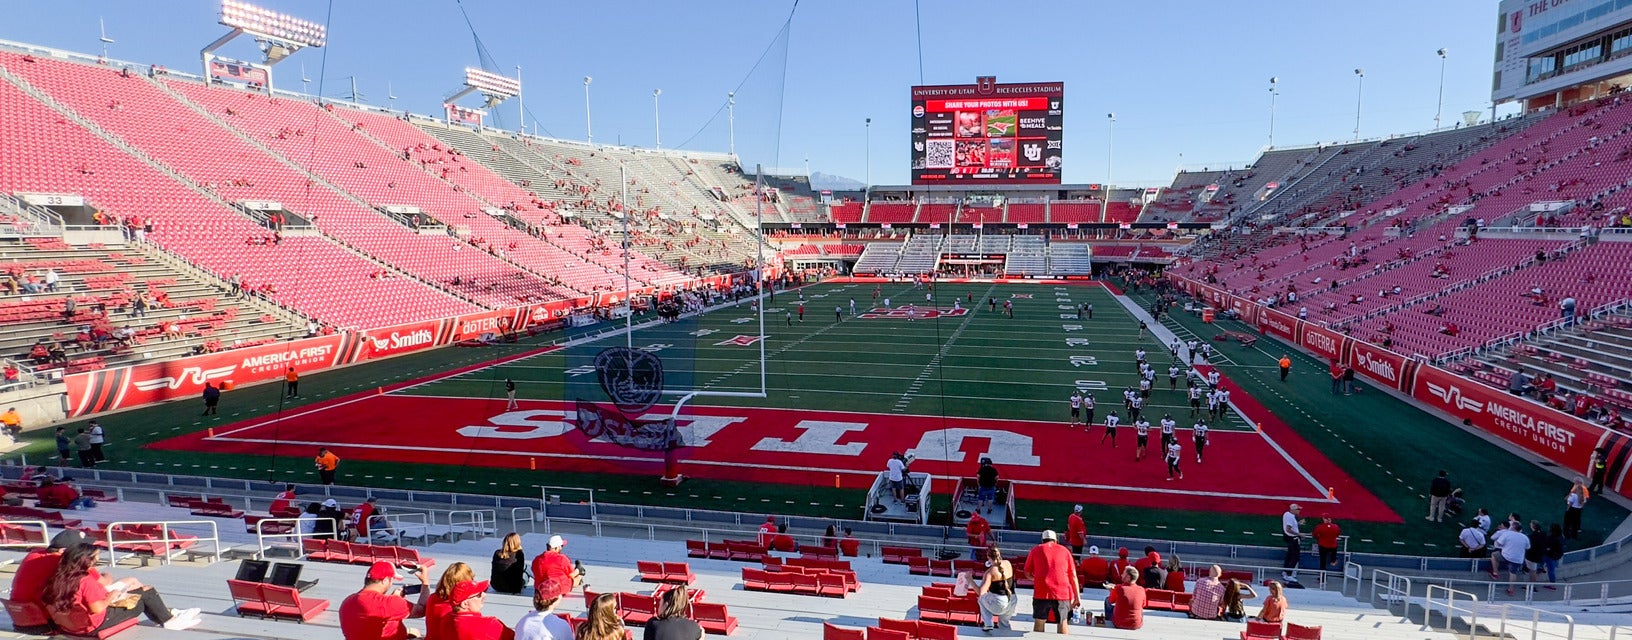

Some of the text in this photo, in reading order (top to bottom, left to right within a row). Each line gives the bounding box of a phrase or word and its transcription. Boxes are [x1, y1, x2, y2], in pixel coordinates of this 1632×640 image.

[1529, 0, 1549, 17] THE
[47, 196, 63, 205] 33
[390, 328, 433, 349] Smith's
[241, 344, 333, 369] AMERICA FIRST
[251, 355, 325, 375] CREDIT UNION
[1366, 351, 1396, 382] Smith's
[1486, 401, 1576, 447] AMERICA FIRST
[1494, 418, 1566, 454] CREDIT UNION
